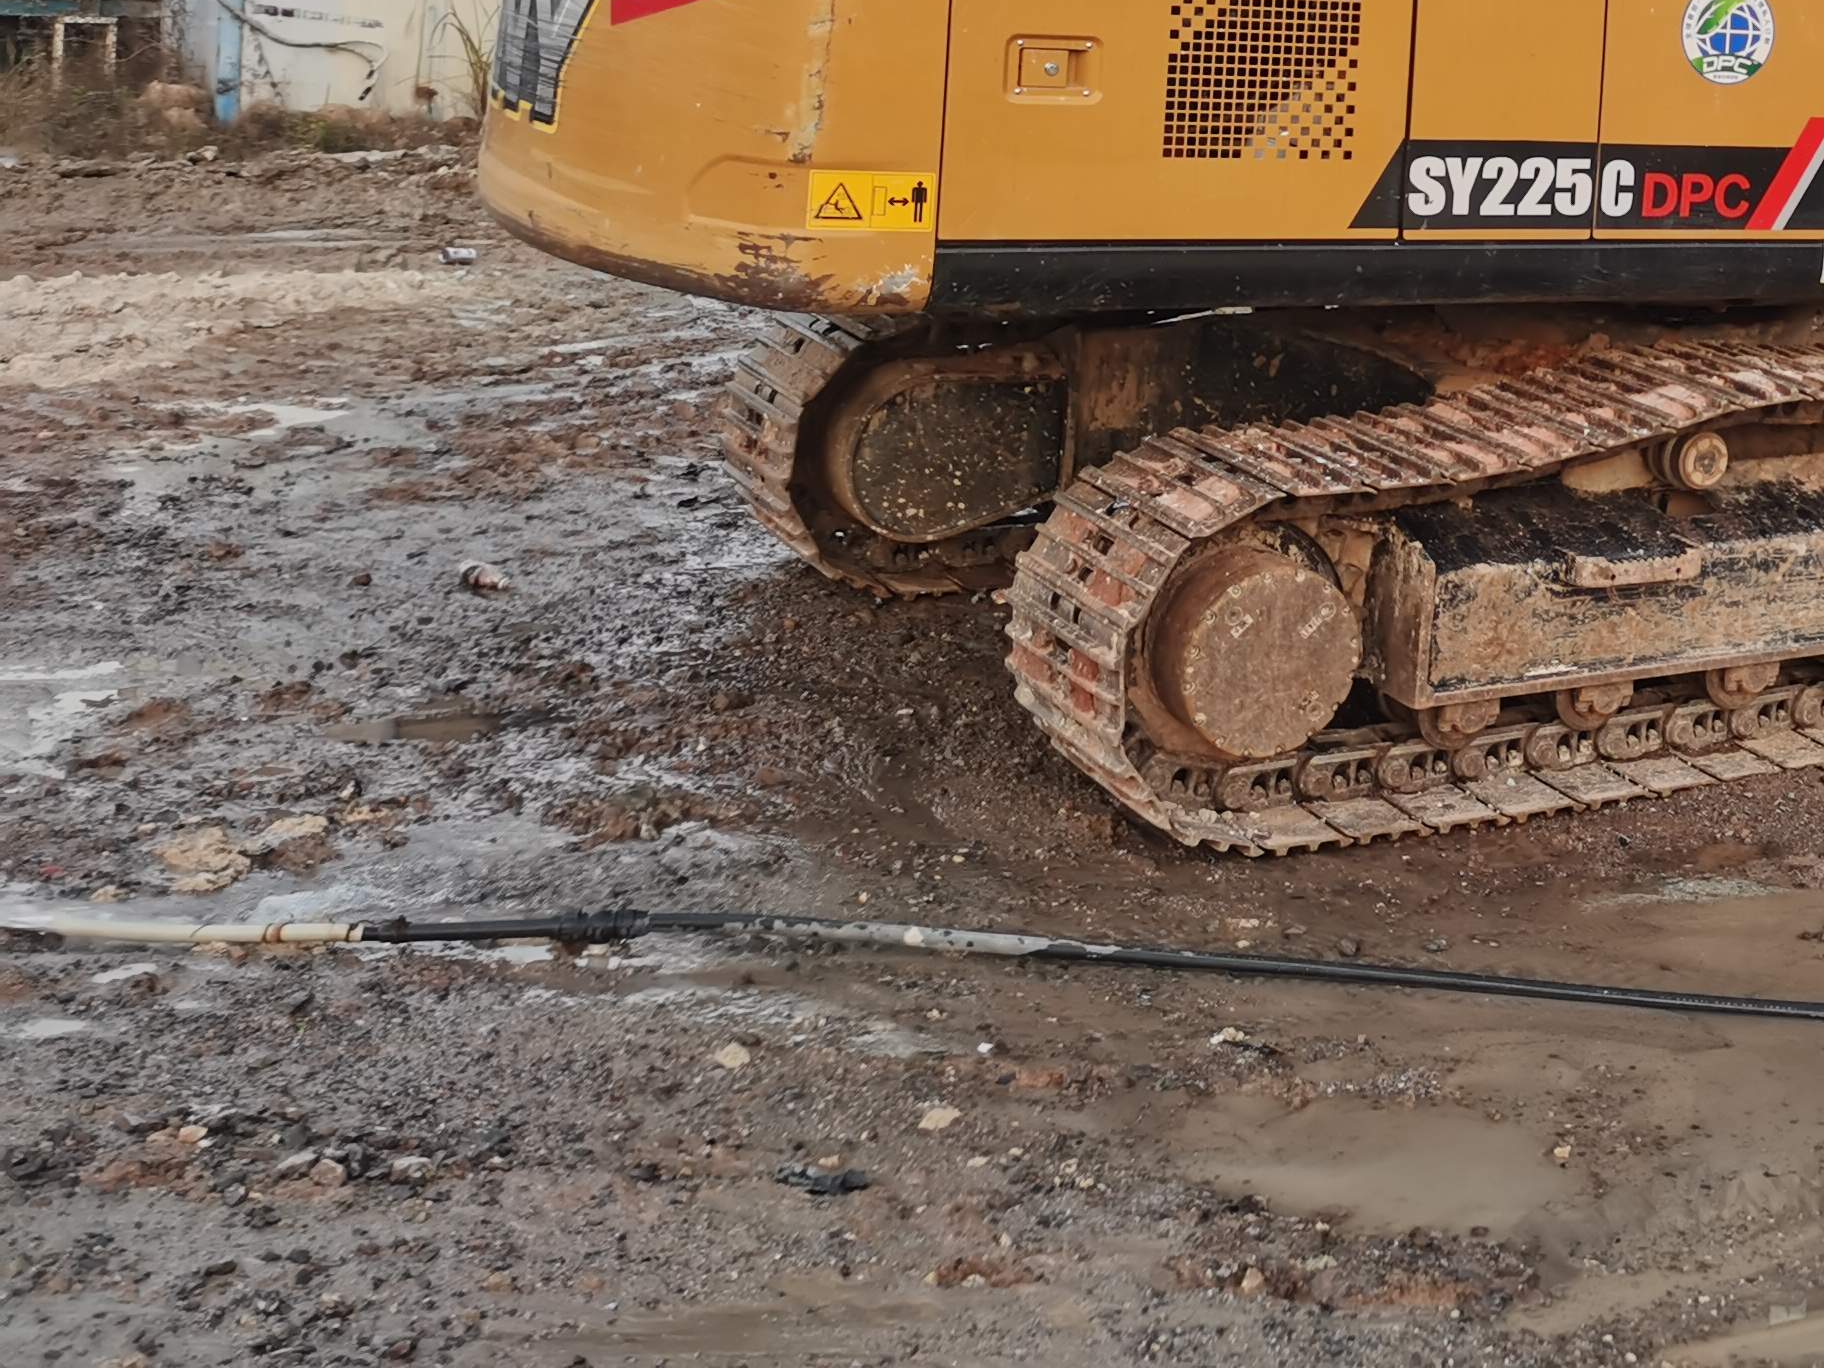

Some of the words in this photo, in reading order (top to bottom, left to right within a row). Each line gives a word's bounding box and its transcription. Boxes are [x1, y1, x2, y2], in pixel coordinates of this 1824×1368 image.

[1702, 55, 1752, 74] DPC
[1407, 156, 1635, 217] SY225C
[1641, 172, 1751, 218] DPC
